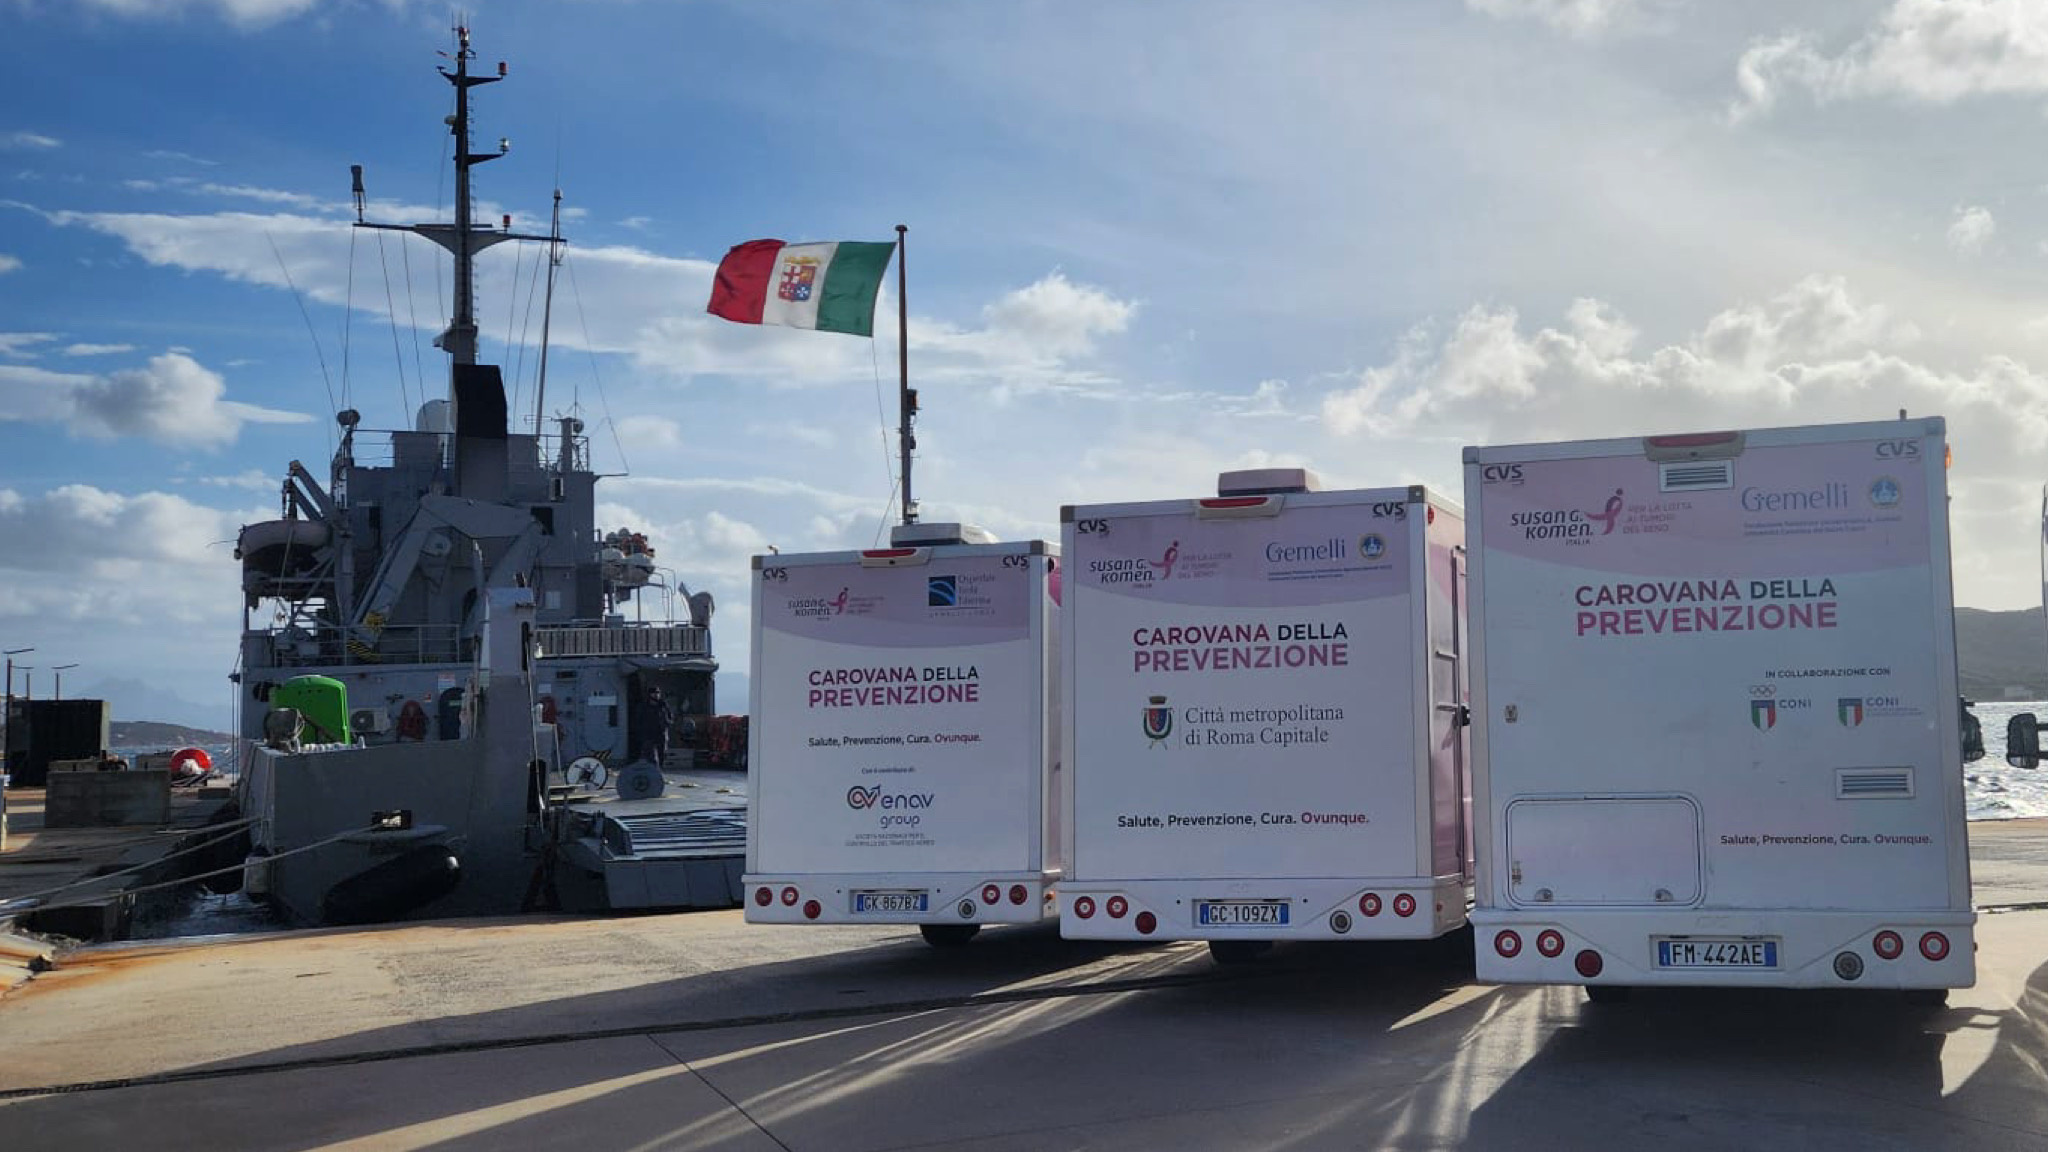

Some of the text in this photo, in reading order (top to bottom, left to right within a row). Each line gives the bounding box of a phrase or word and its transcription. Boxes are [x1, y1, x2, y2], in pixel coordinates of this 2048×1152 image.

[1876, 441, 1920, 457] CVS
[1484, 465, 1524, 481] CVS
[1741, 482, 1848, 511] Gemelli
[1373, 502, 1406, 518] CVS
[1078, 518, 1110, 534] CVS
[1511, 511, 1566, 526] susan
[1266, 538, 1345, 562] Gemelli
[1002, 556, 1029, 569] CVS
[1089, 559, 1133, 572] susan
[763, 567, 788, 580] CVS
[1575, 578, 1837, 607] CAROVANA DELLA
[1577, 602, 1838, 636] PREVENZIONE
[1133, 622, 1348, 646] CAROVANA DELLA
[1133, 643, 1349, 672] PREVENZIONE
[809, 666, 978, 686] CAROVANA DELLA
[1778, 669, 1867, 678] COLLABORAZIONE
[1869, 668, 1891, 676] CON
[808, 683, 980, 708] PREVENZIONE
[1866, 696, 1899, 707] CONI
[1779, 699, 1812, 709] CONI
[1185, 705, 1345, 726] Città metropolitana
[1185, 727, 1329, 747] di Roma Capitale
[881, 794, 935, 809] enav
[880, 815, 921, 828] group
[1118, 812, 1370, 828] Salute, Prevenzione, Cura. Ovunque.
[1720, 833, 1933, 847] Salute, Prevenzione, Cura. Ovunque.
